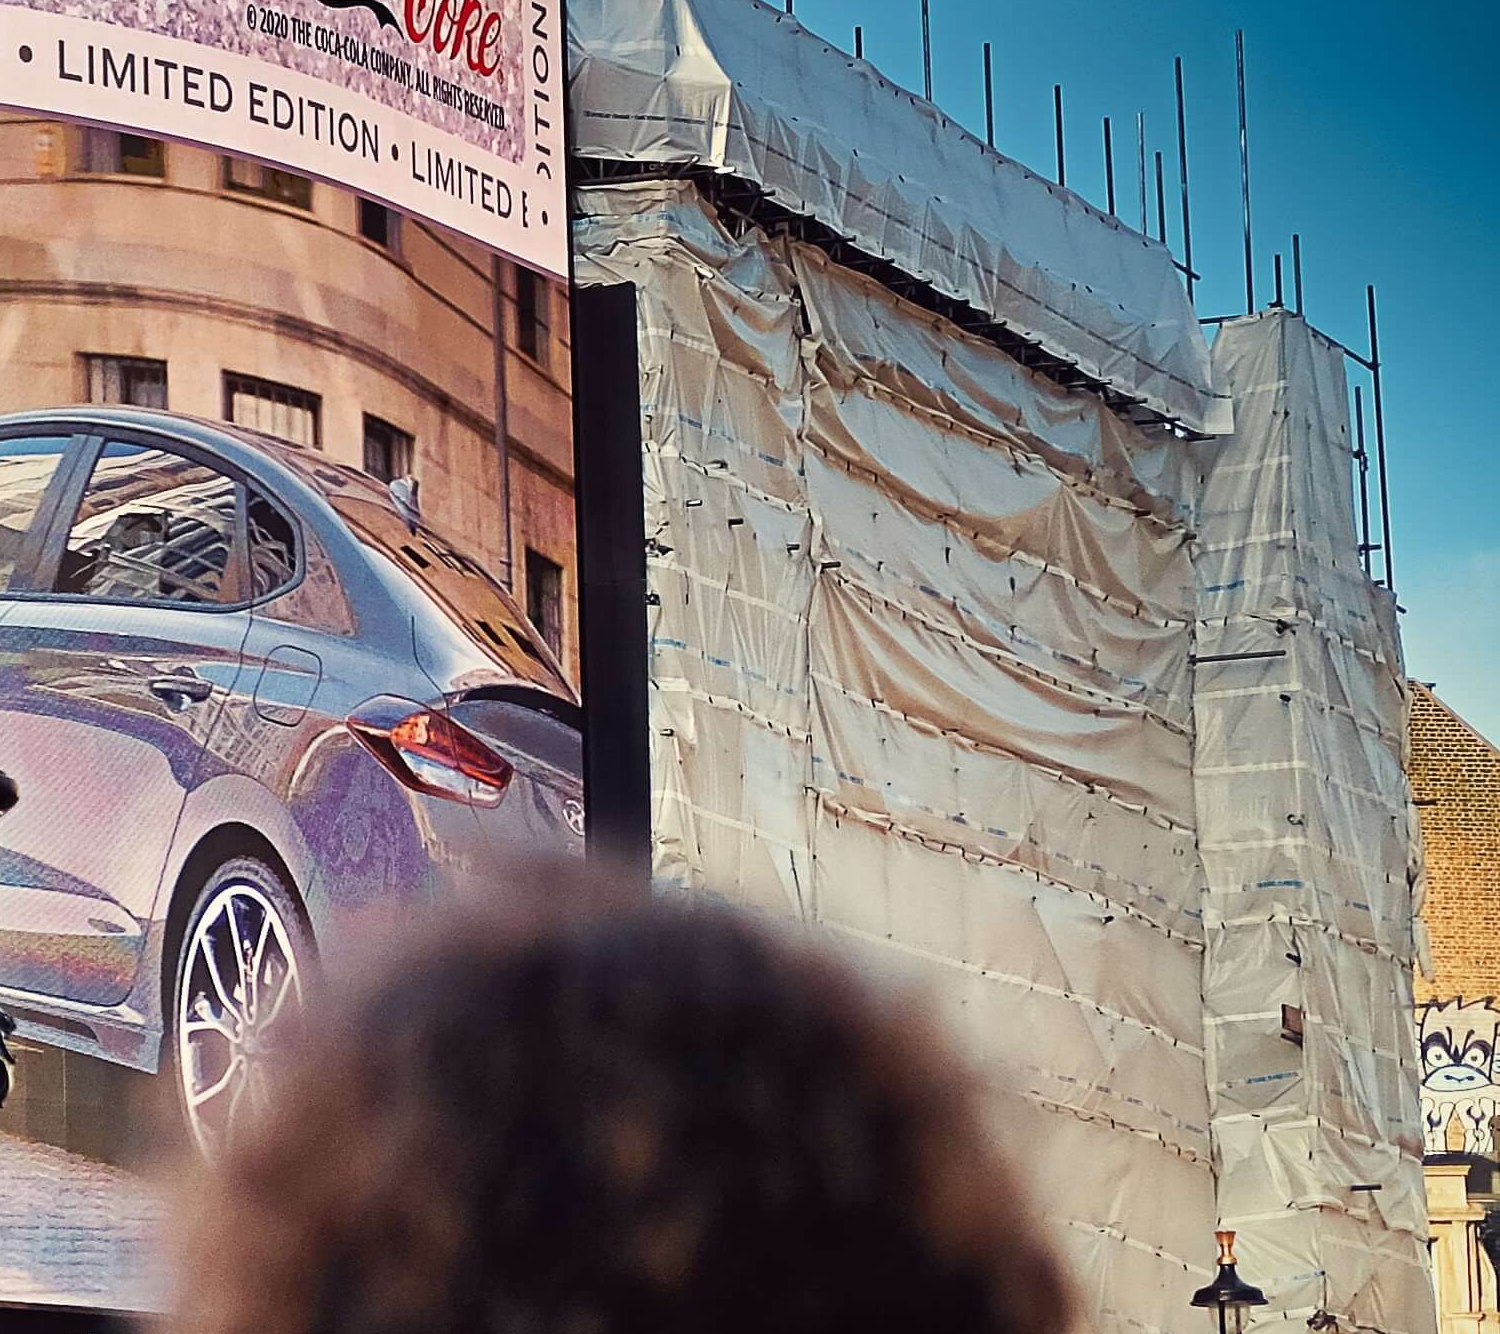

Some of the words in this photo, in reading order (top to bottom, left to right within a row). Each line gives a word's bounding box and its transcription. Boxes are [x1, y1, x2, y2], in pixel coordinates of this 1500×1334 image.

[58, 38, 234, 113] LIMITED
[248, 82, 381, 163] EDITION
[411, 140, 512, 219] LIMITED
[259, 7, 289, 40] 2020
[290, 17, 312, 47] THE
[314, 25, 369, 69] COCA-COLA
[415, 71, 432, 98] ALL
[432, 77, 463, 112] RIGHTS
